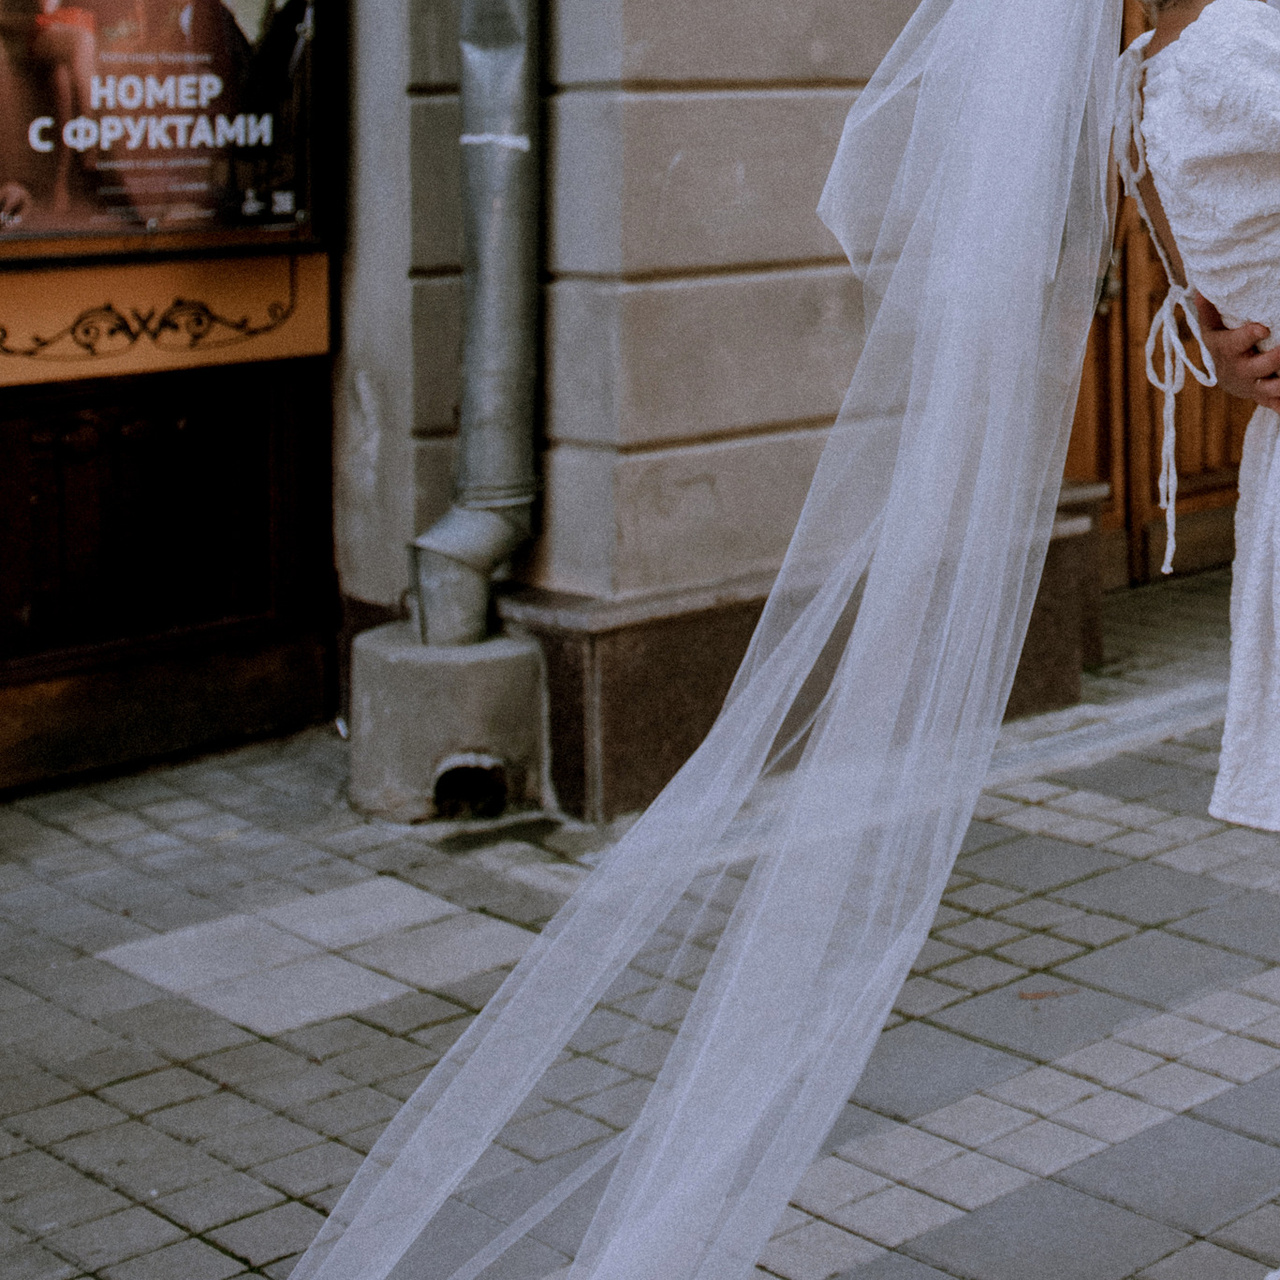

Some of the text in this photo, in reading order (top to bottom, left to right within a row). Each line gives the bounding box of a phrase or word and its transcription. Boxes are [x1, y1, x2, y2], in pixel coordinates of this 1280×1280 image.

[90, 74, 223, 110] НОМЕР
[28, 113, 273, 152] С ФРУКТАМИ
